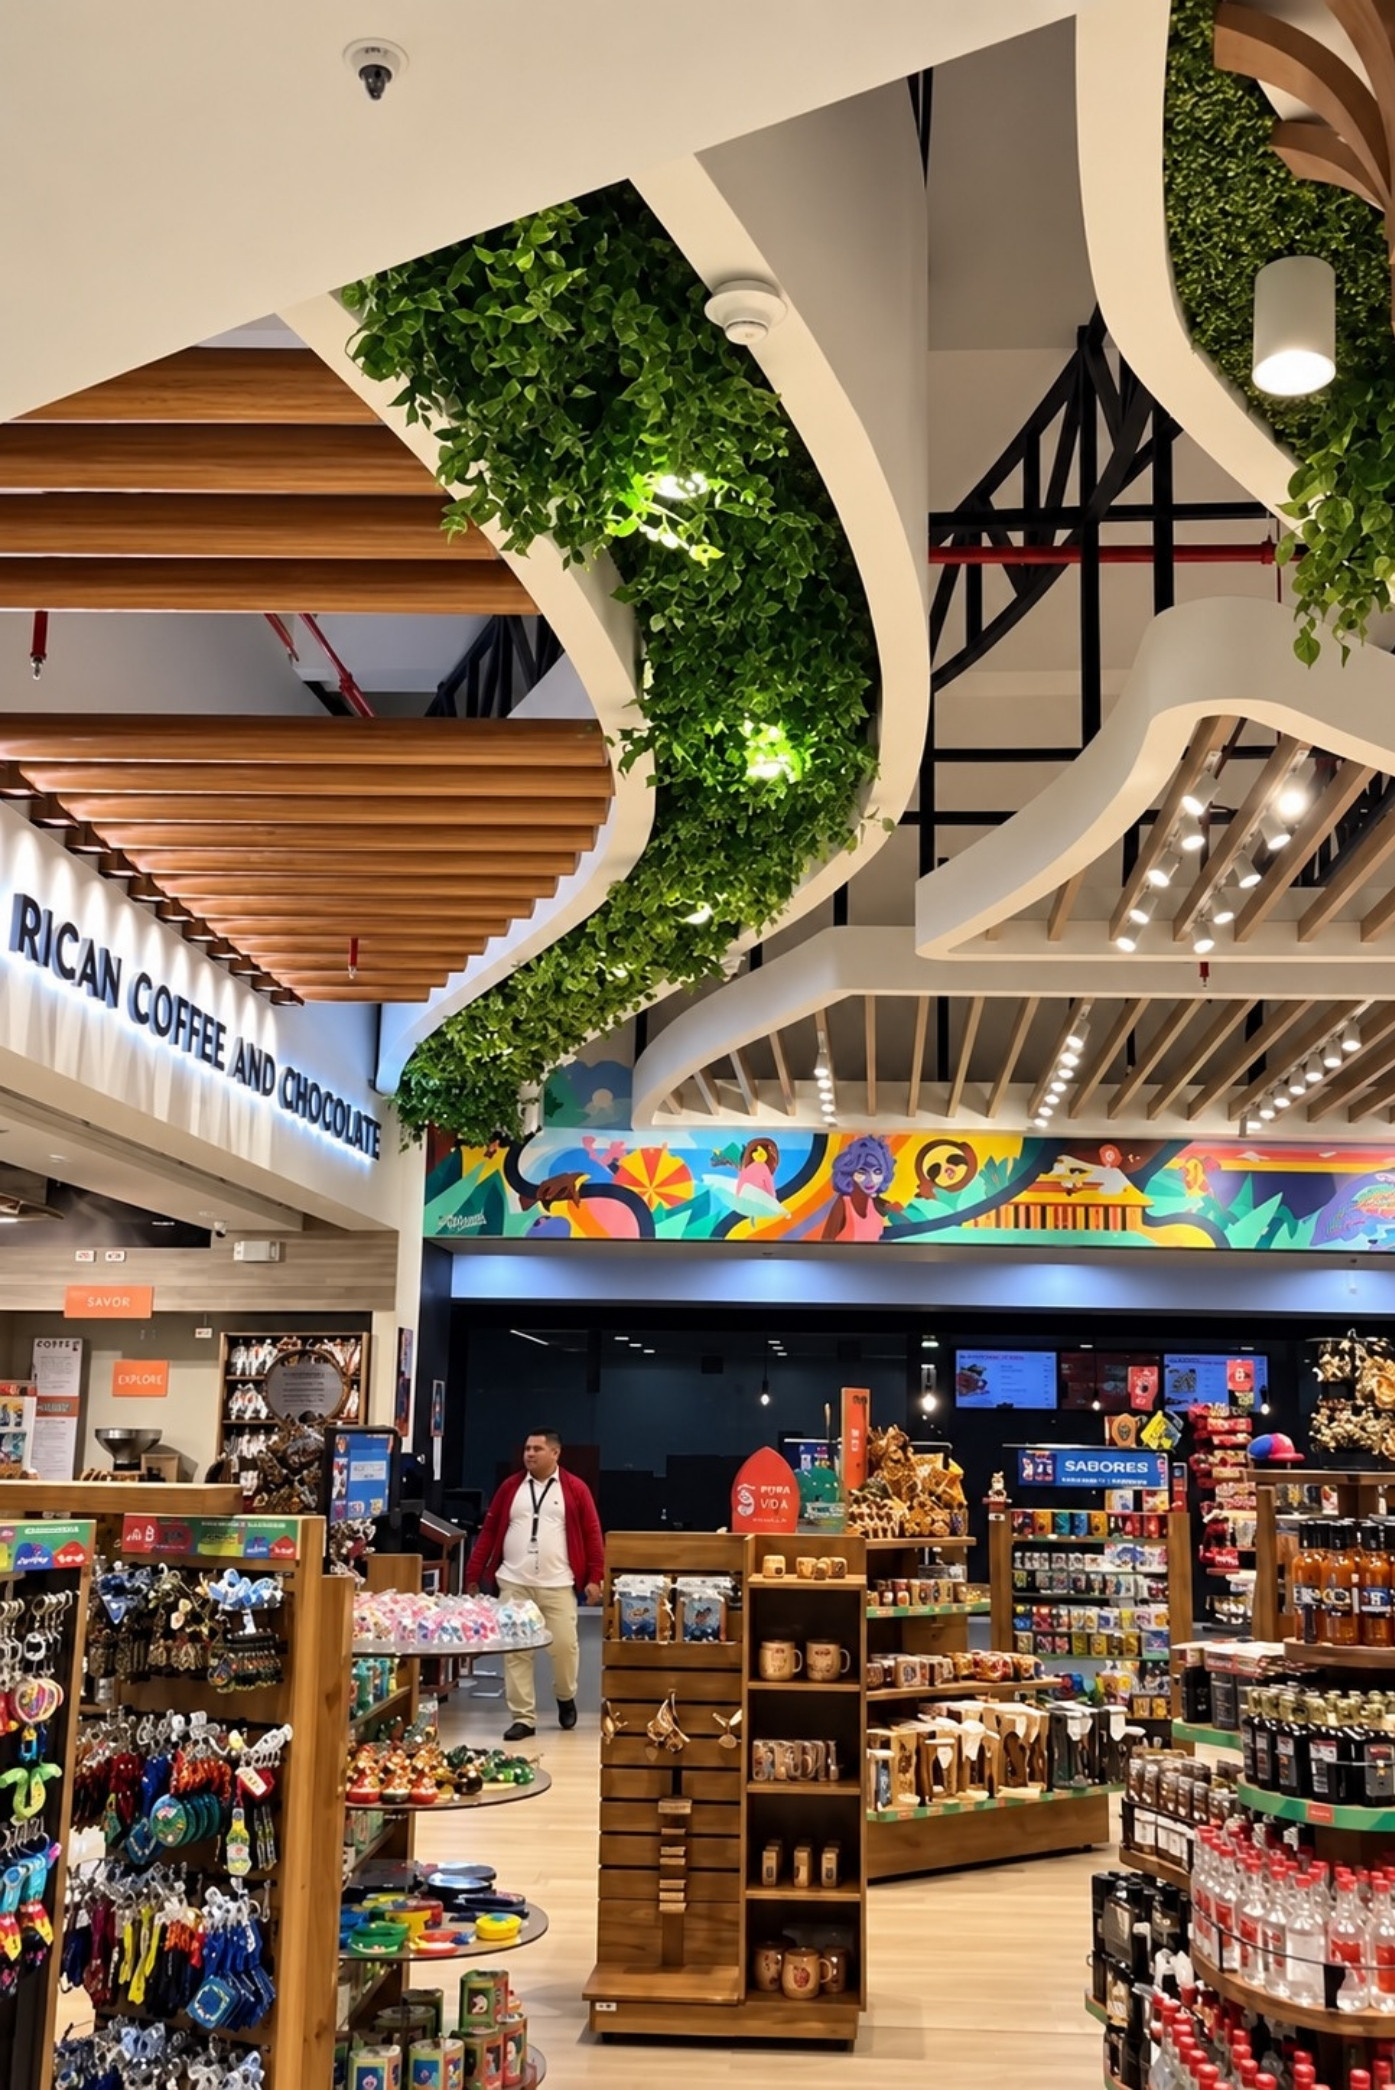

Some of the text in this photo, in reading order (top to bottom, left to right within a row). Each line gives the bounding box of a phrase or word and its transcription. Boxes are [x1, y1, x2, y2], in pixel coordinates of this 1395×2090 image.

[9, 893, 382, 1160] RICAN COFFEE AND CHOCOLATE
[86, 1296, 131, 1308] SAVOR
[117, 1374, 163, 1385] EXPLORE
[1064, 1460, 1149, 1473] SABORES
[760, 1485, 791, 1495] PURA
